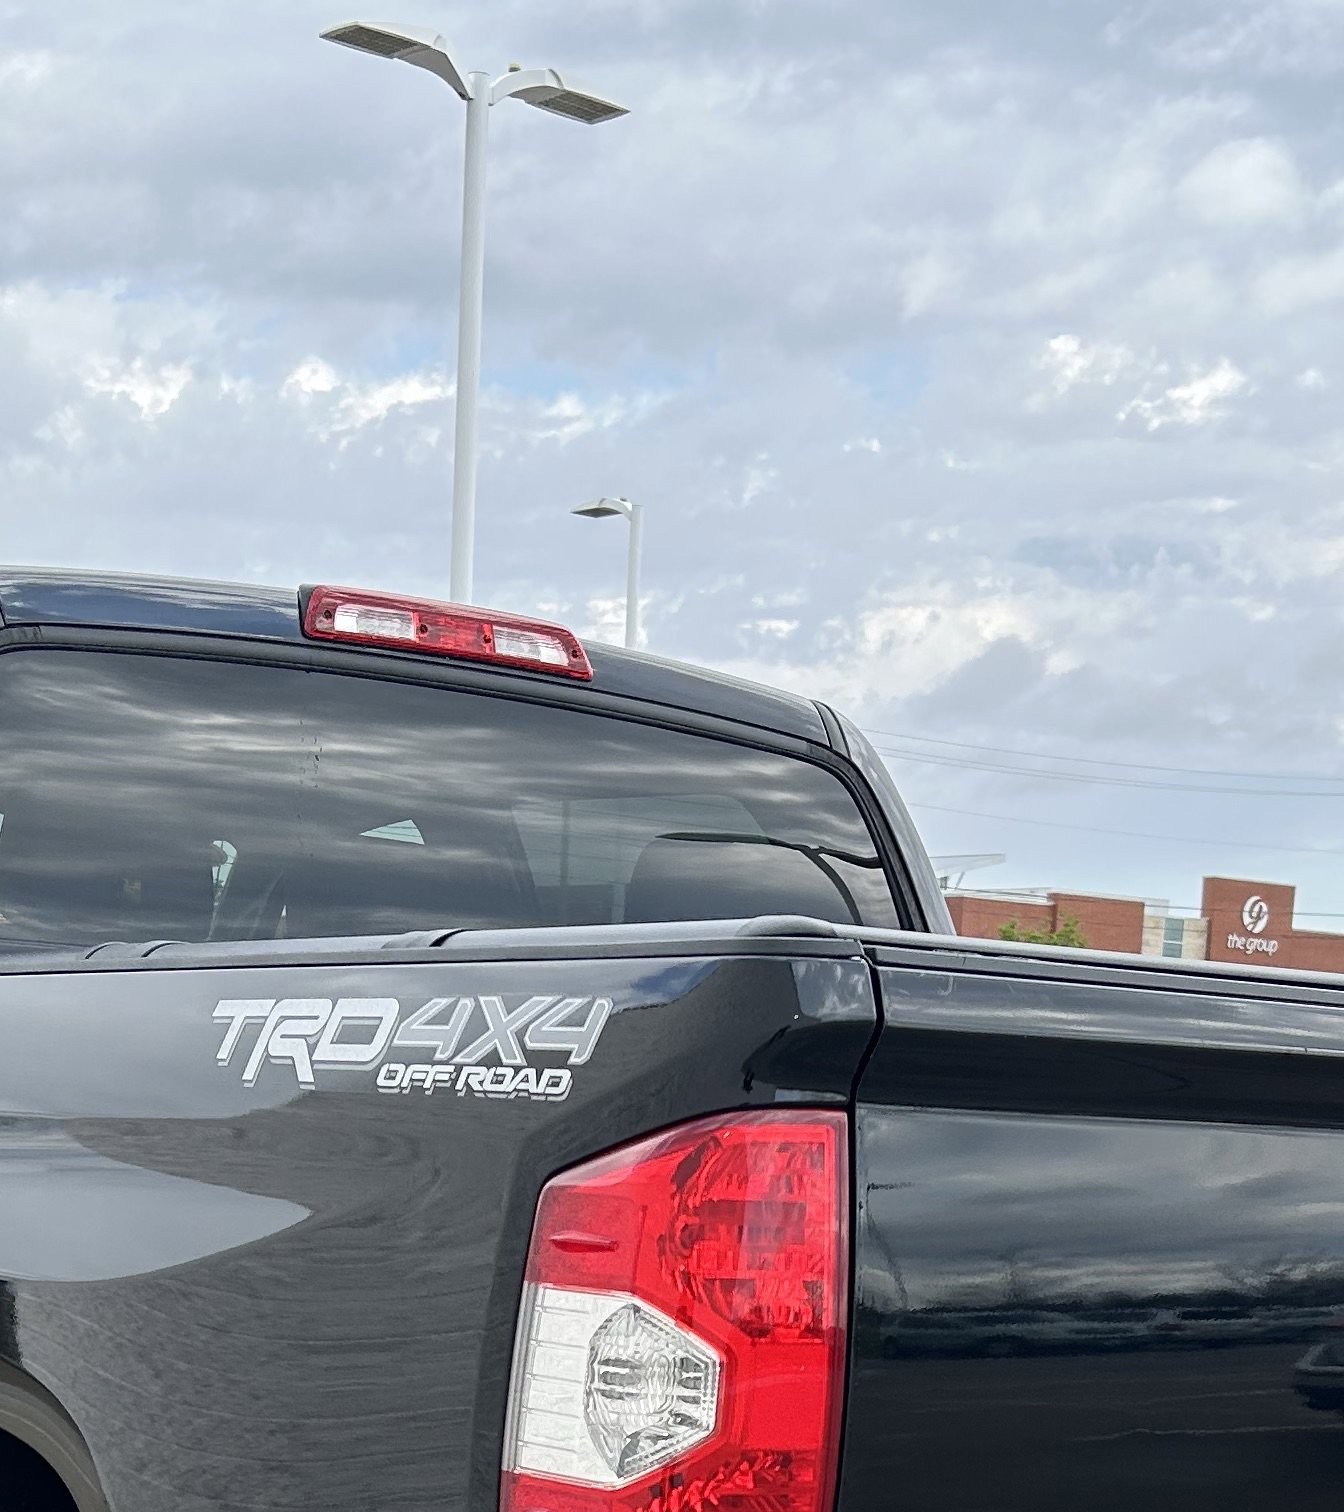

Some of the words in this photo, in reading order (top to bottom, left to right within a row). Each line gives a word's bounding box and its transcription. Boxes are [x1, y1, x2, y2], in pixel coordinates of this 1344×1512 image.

[1227, 933, 1246, 950] the
[1246, 937, 1278, 956] group
[212, 998, 401, 1090] TRD
[376, 1063, 455, 1094] OFF
[455, 1065, 575, 1101] ROAD
